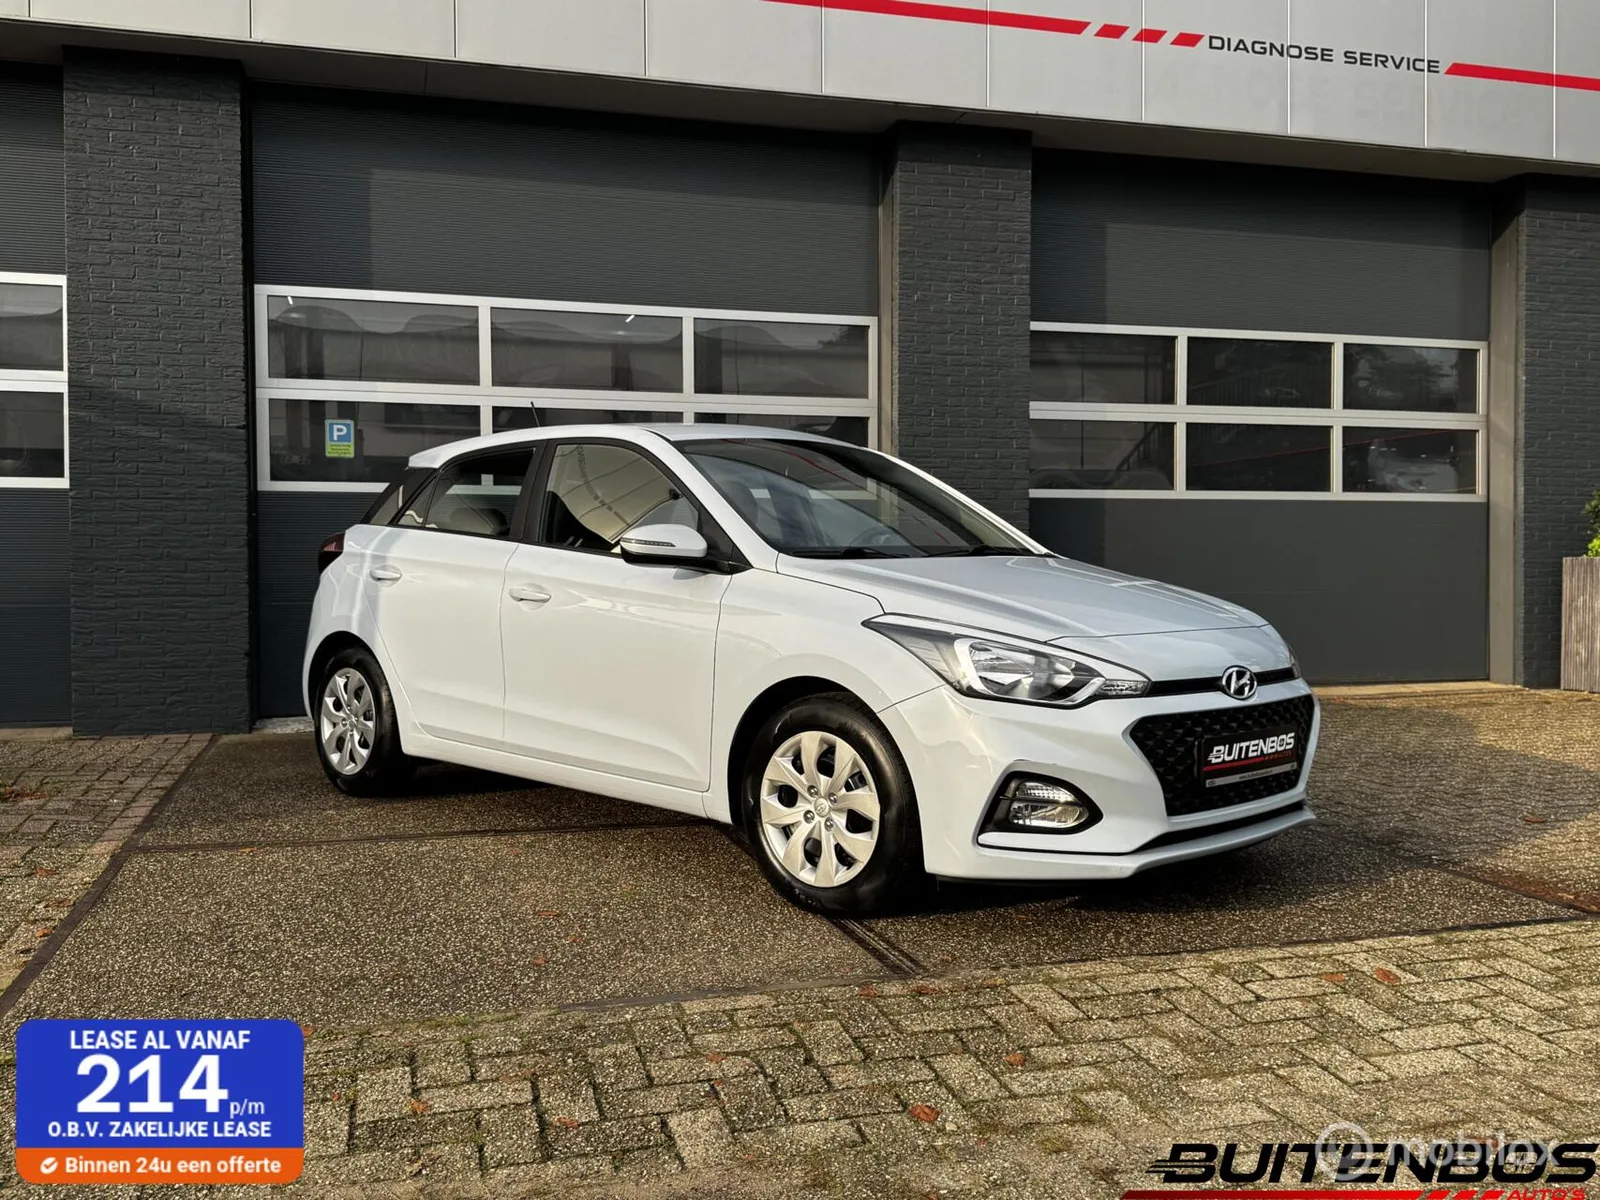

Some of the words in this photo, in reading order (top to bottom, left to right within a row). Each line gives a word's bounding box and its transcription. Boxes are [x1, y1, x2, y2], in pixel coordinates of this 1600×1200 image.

[1208, 35, 1334, 63] DIAGNOSE
[1343, 50, 1441, 74] SERVICE
[333, 424, 348, 441] P
[1207, 732, 1296, 764] BUITENBOS
